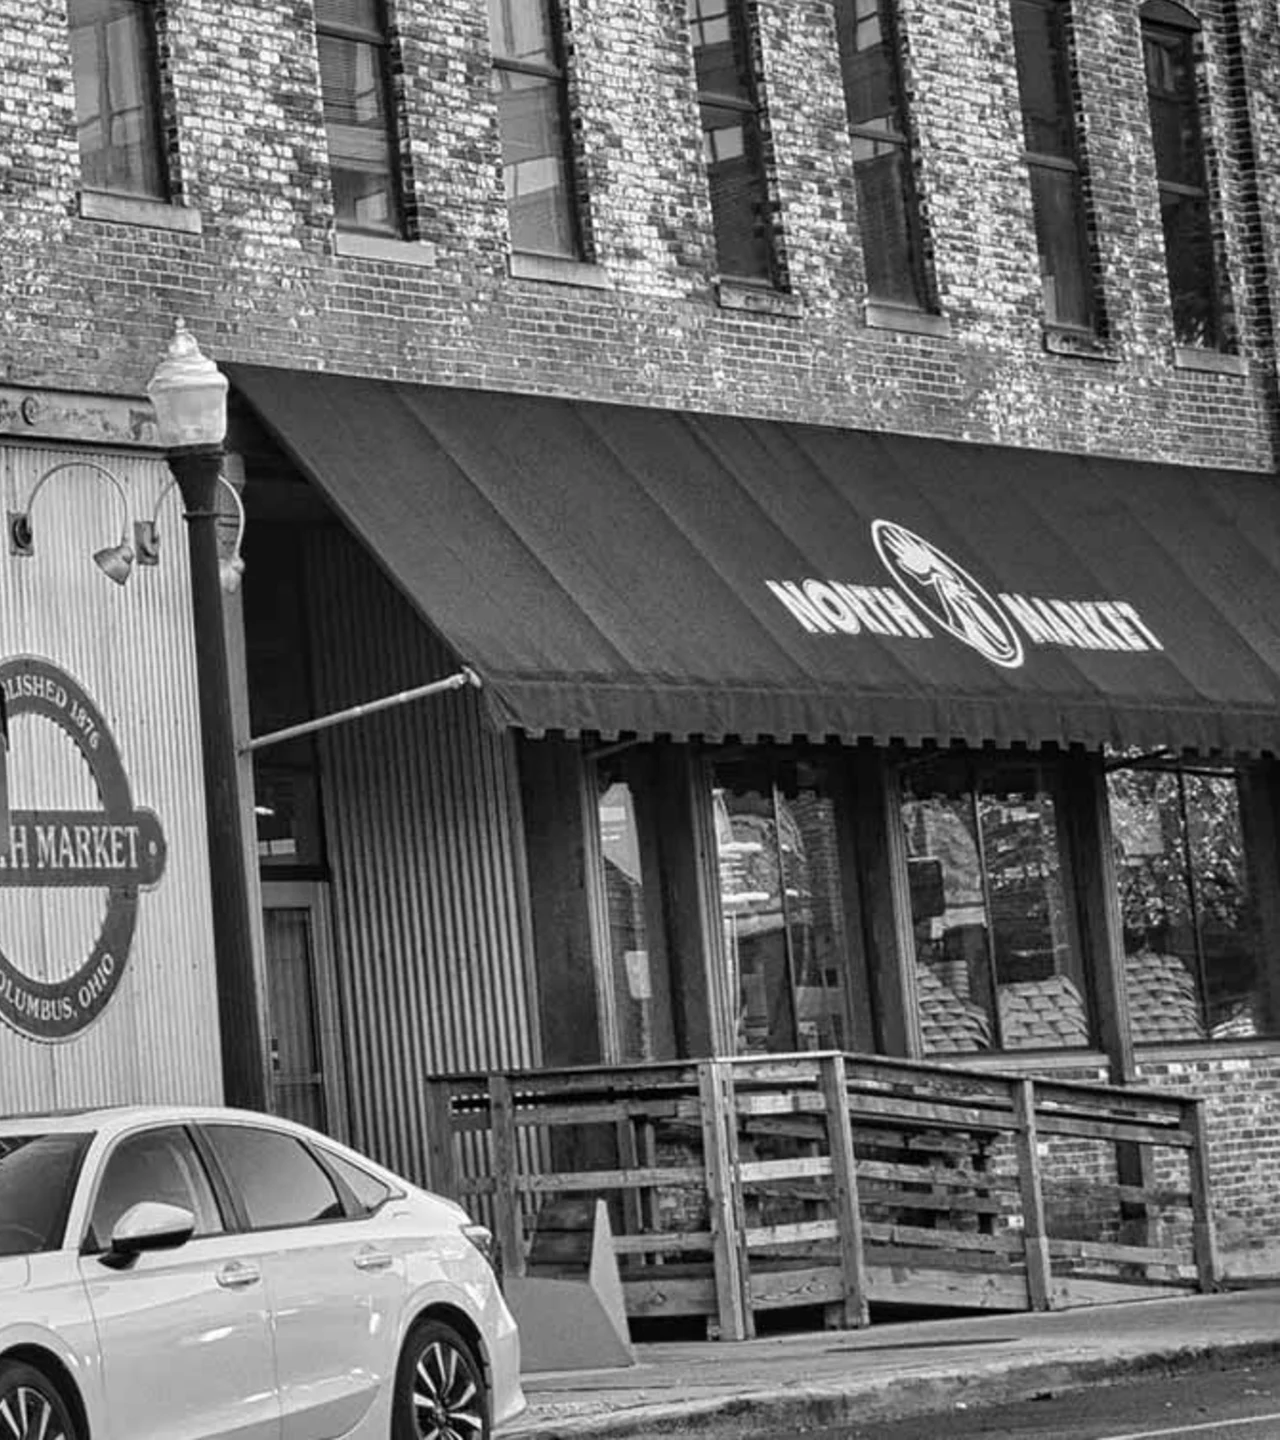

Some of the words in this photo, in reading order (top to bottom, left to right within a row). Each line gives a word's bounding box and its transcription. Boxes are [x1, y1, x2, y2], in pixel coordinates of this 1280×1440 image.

[997, 592, 1165, 650] MARKET
[4, 674, 68, 708] LISHED
[69, 700, 101, 750] 1876
[34, 825, 141, 869] MARKET
[77, 952, 116, 1009] OHIO
